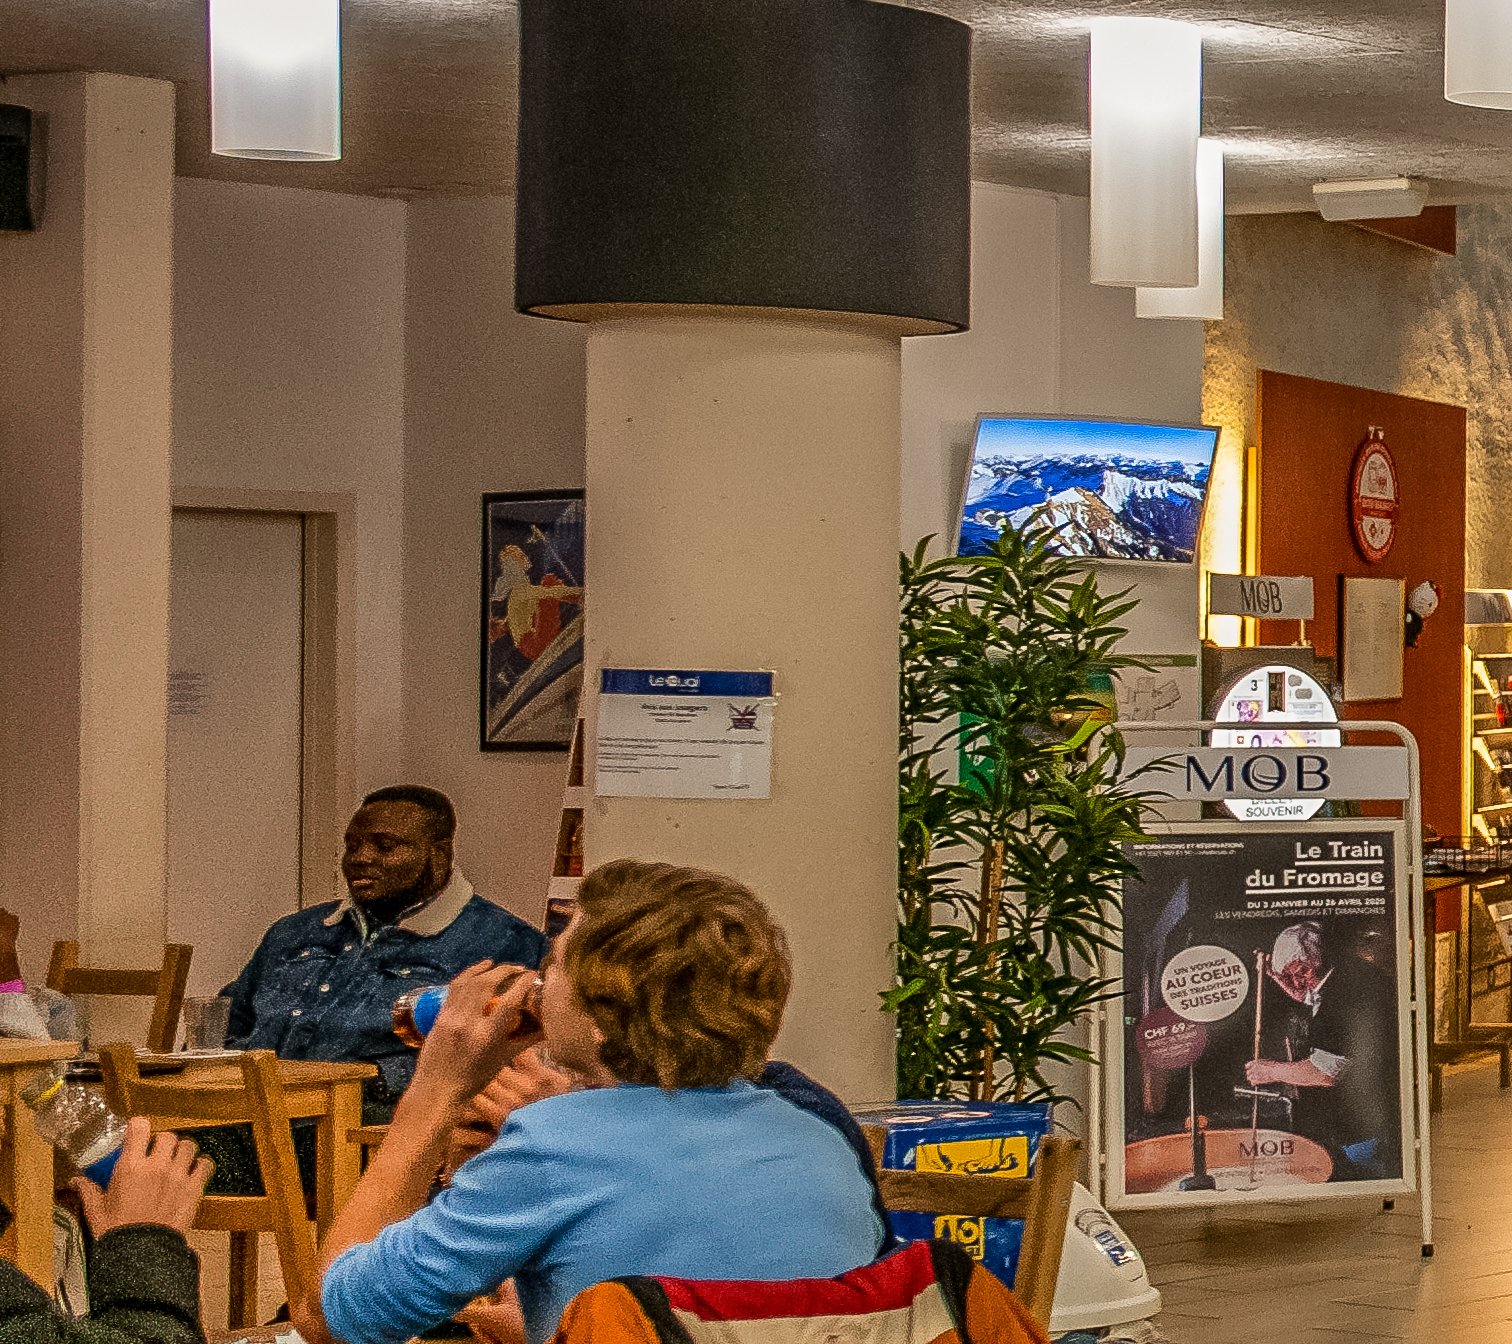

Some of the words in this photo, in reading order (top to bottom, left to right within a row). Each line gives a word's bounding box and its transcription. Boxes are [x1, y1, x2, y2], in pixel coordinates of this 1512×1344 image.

[1186, 753, 1331, 793] MOB
[1246, 806, 1304, 817] SOUVENIR
[1296, 842, 1321, 859] Le
[1328, 841, 1383, 859] Train
[1246, 869, 1274, 887] du
[1283, 867, 1383, 889] Fromage
[1166, 976, 1188, 991] AU
[1191, 964, 1243, 986] COEUR
[1181, 988, 1239, 1011] SUISSES
[1238, 1139, 1296, 1160] MOB
